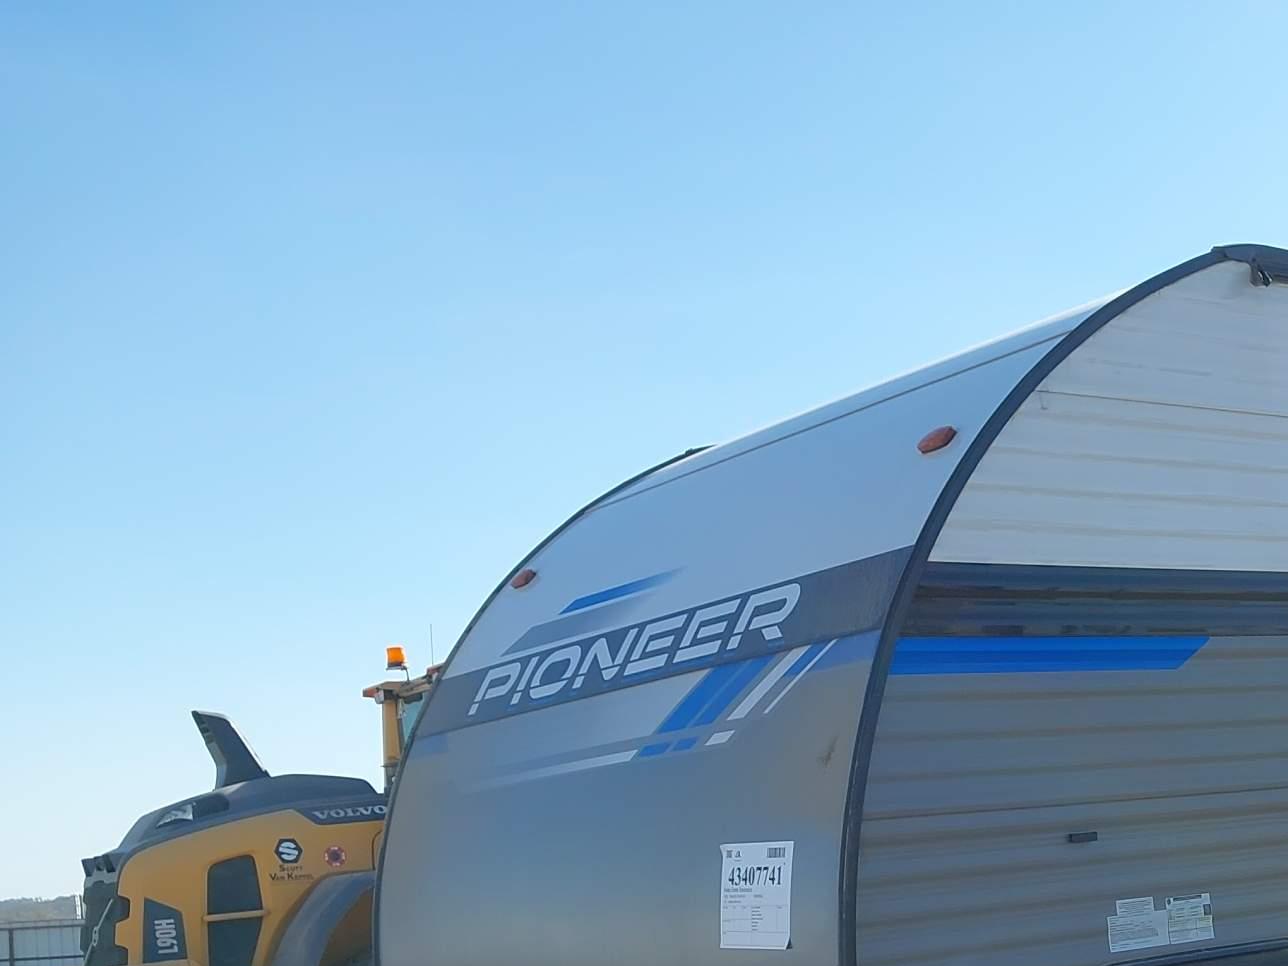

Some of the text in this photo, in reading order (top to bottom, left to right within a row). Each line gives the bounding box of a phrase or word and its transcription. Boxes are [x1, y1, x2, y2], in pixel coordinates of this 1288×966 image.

[468, 583, 801, 716] PIONEER
[312, 805, 387, 820] VOLVO
[728, 865, 782, 887] 43407741
[154, 919, 178, 954] L90H
